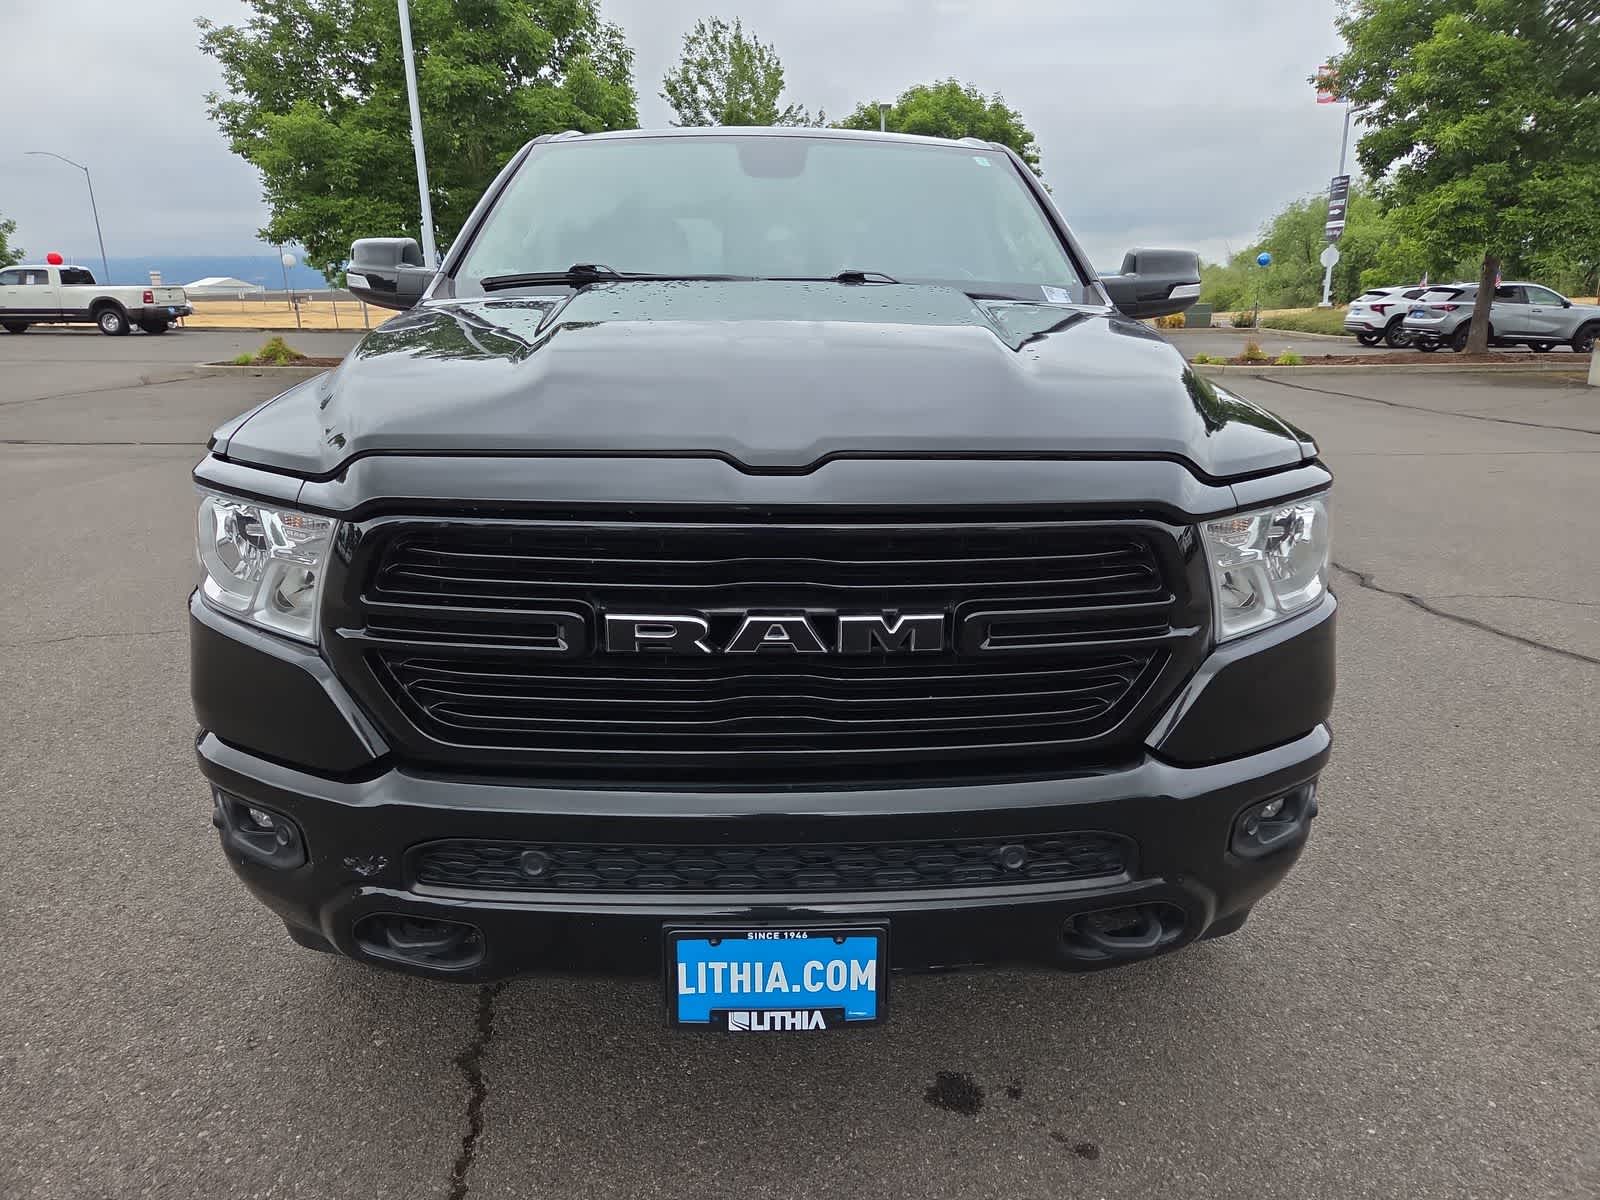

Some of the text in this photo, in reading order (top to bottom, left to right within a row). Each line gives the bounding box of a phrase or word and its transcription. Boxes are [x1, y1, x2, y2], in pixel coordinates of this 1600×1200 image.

[604, 613, 945, 654] RAM
[747, 931, 808, 940] SINCE 1946
[677, 959, 877, 995] LITHIA.COM
[750, 1010, 827, 1031] LITHIA
